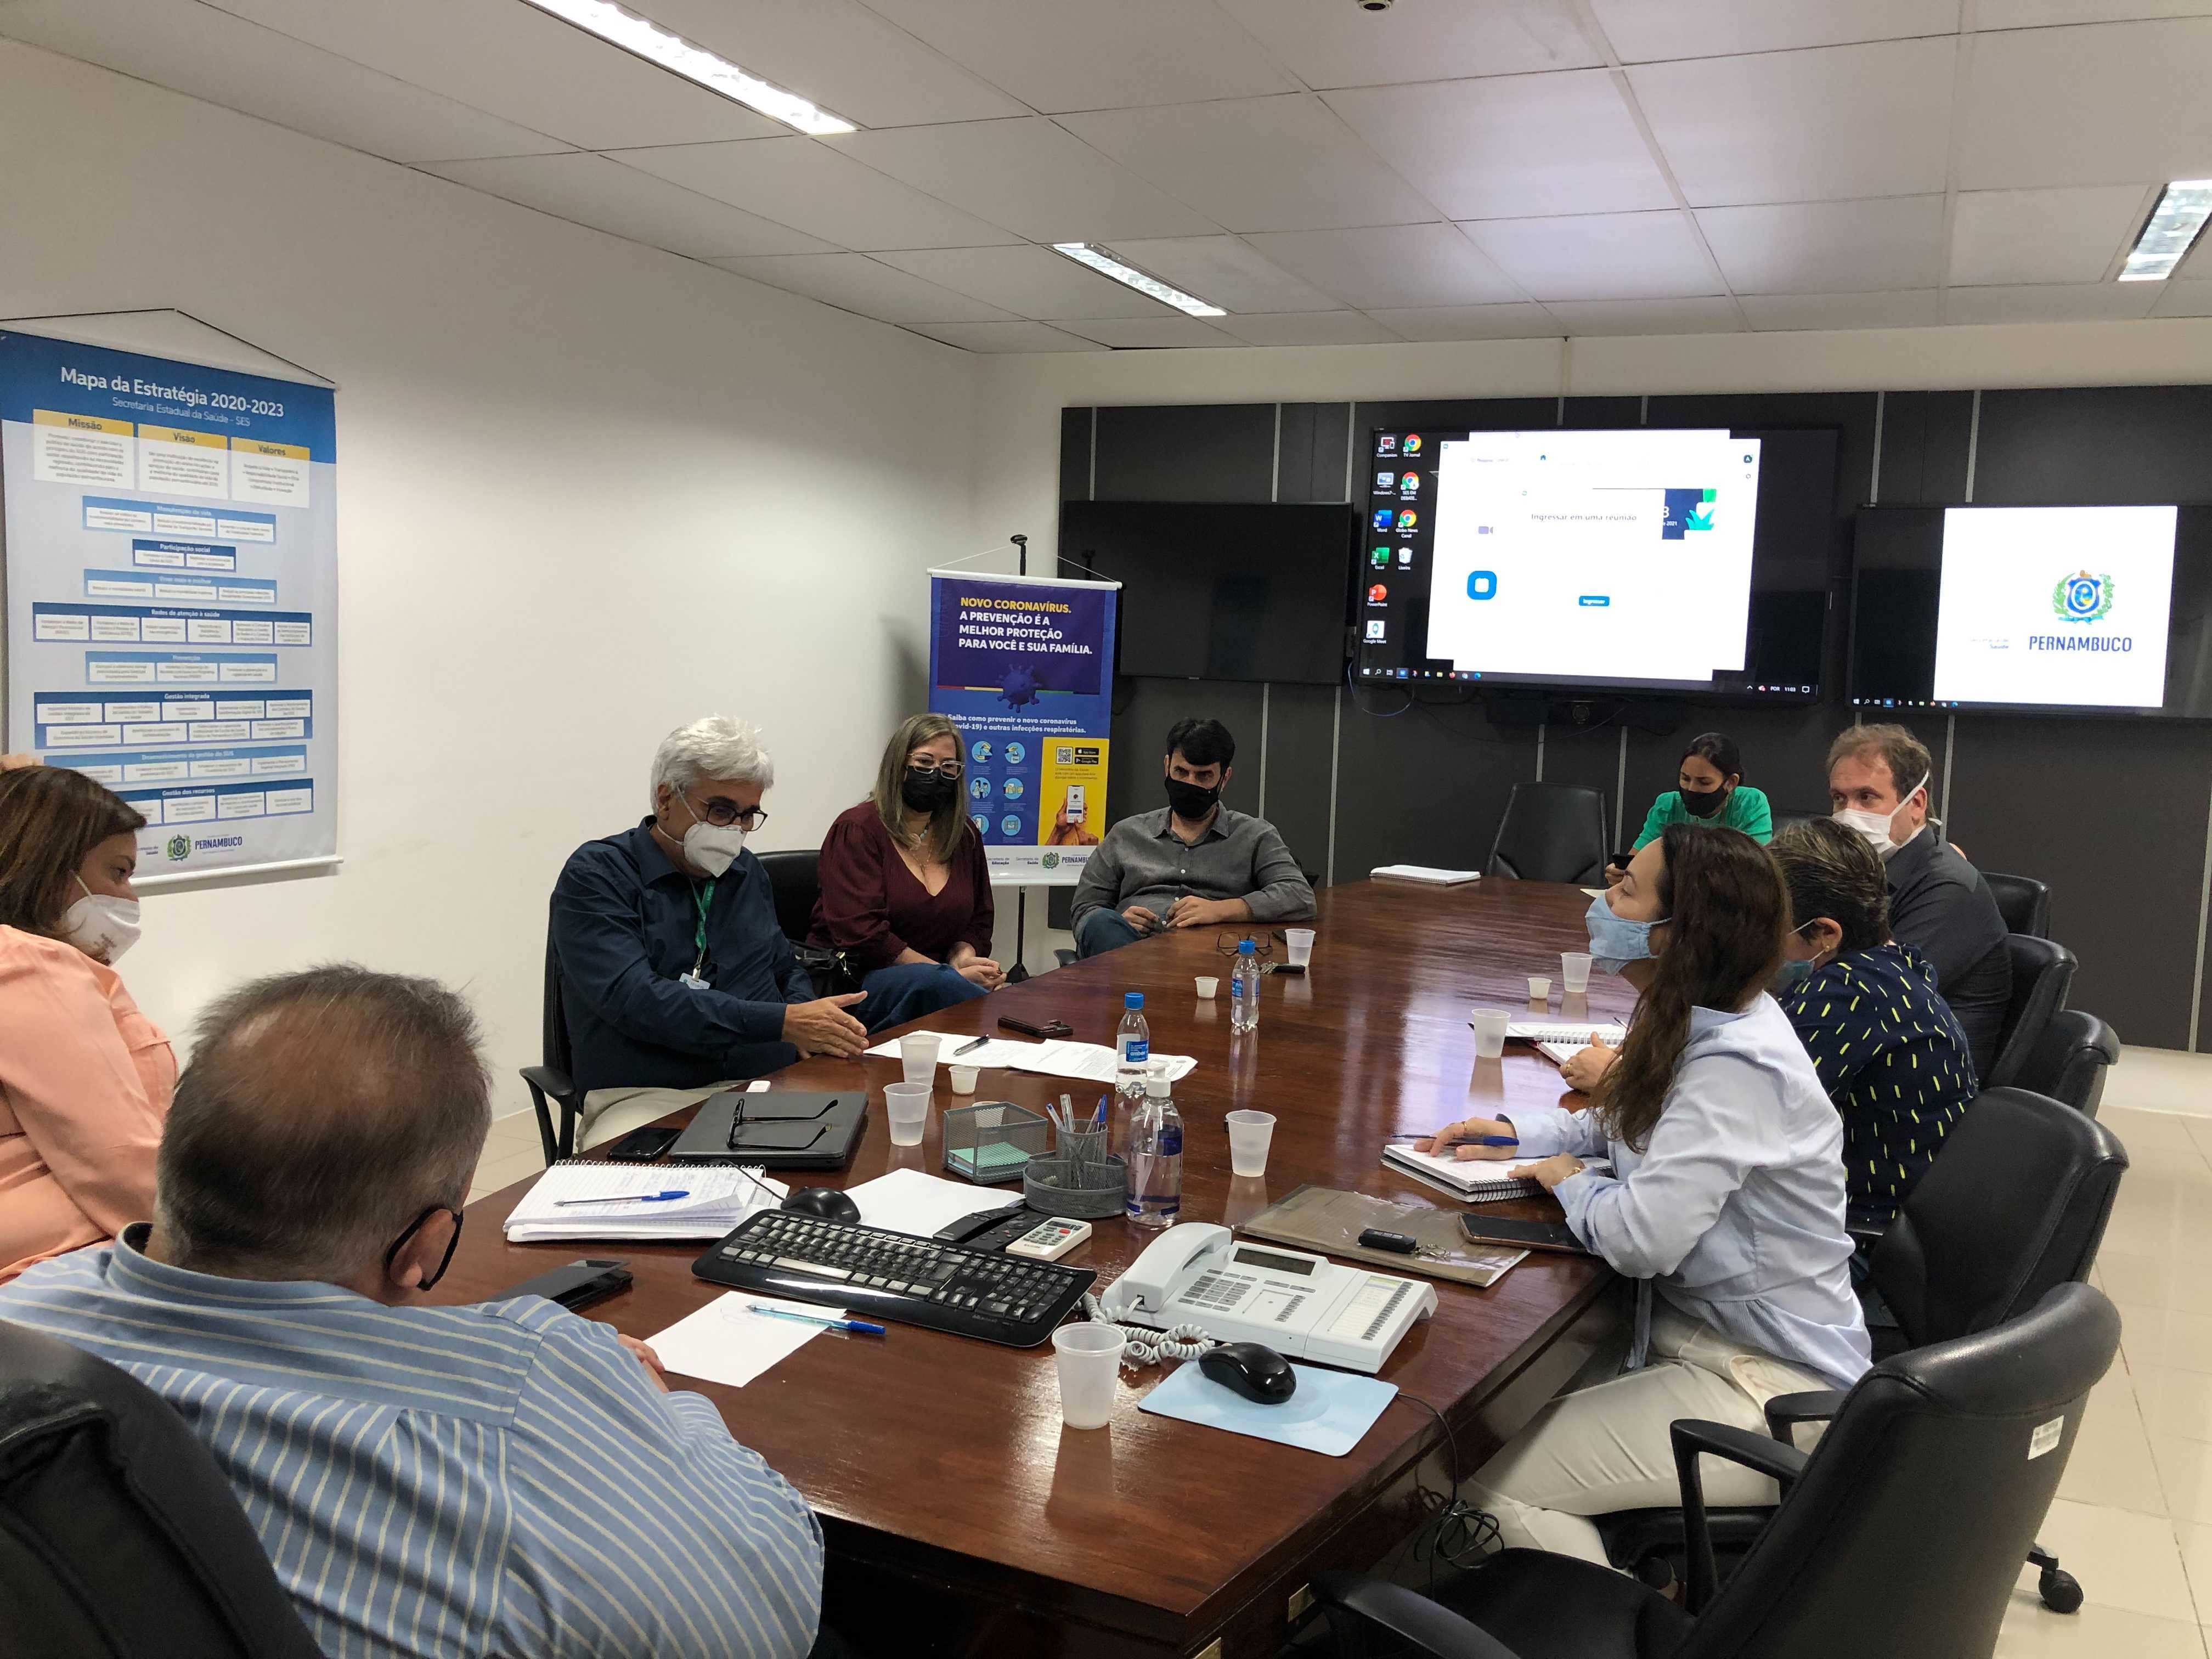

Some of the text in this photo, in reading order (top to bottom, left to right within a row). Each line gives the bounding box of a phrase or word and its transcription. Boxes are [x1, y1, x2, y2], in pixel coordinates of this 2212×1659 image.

[61, 366, 284, 417] Mapa da Estratégia 2020-2023
[112, 397, 154, 412] Secretaria
[156, 404, 190, 417] Estadual
[192, 410, 202, 419] da
[204, 411, 229, 424] Saúde
[236, 416, 250, 426] SES
[68, 418, 102, 430] Missão
[173, 432, 195, 443] Visão
[258, 444, 286, 456] Valores
[1531, 514, 1567, 522] Ingressar
[961, 597, 1071, 613] NOVO CORONAVÍRUS.
[960, 611, 1050, 626] A PREVENÇÃO É A
[959, 624, 1063, 641] MELHOR PROTEÇÃO
[958, 638, 1093, 654] PARA VOCÊ E SUA FAMÍLIA.
[2029, 635, 2132, 652] PERNAMBUCO
[955, 723, 982, 731] ovid-19)
[1012, 725, 1042, 733] infecções
[1043, 725, 1086, 733] respiratórias.
[195, 836, 242, 850] PERNAMBUCO
